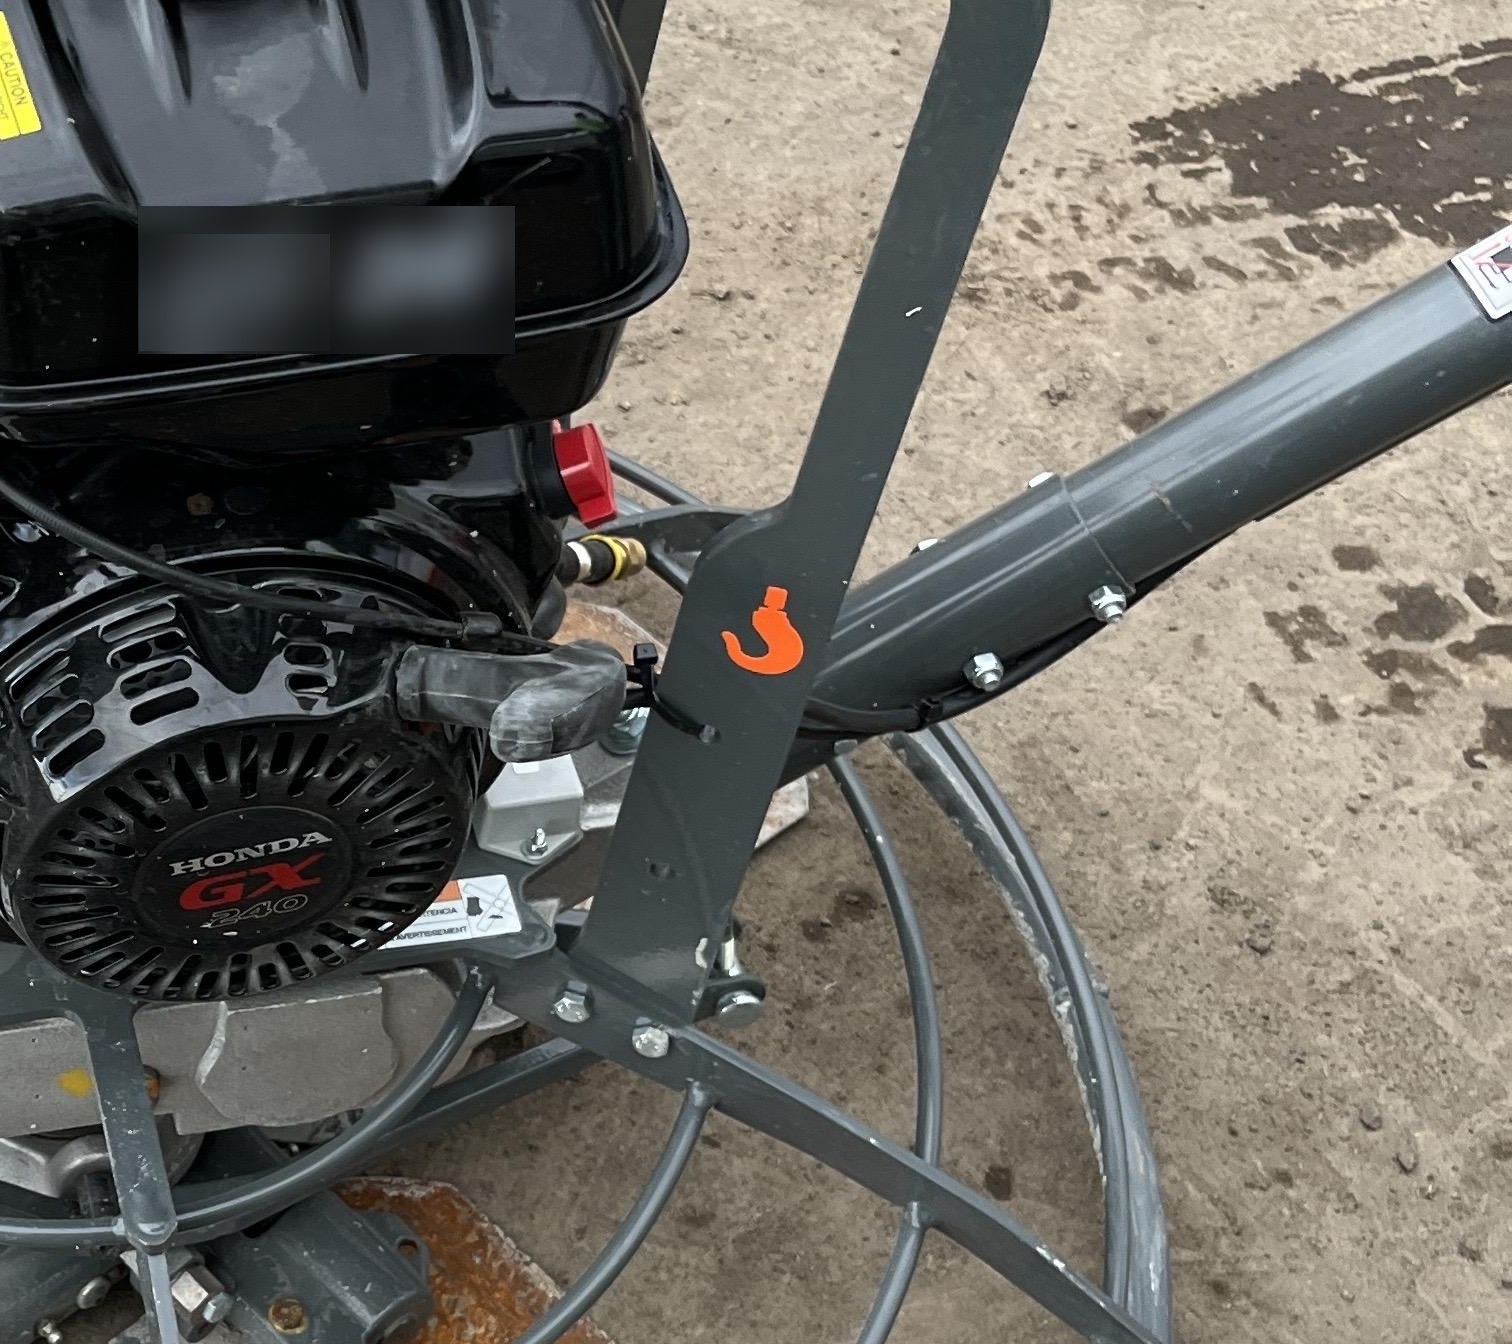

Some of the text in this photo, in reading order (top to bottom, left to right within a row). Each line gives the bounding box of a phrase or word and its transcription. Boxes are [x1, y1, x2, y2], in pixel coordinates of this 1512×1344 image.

[0, 51, 28, 106] CAUTION
[169, 831, 333, 877] HONDA
[179, 852, 326, 911] GX
[208, 893, 309, 929] 240
